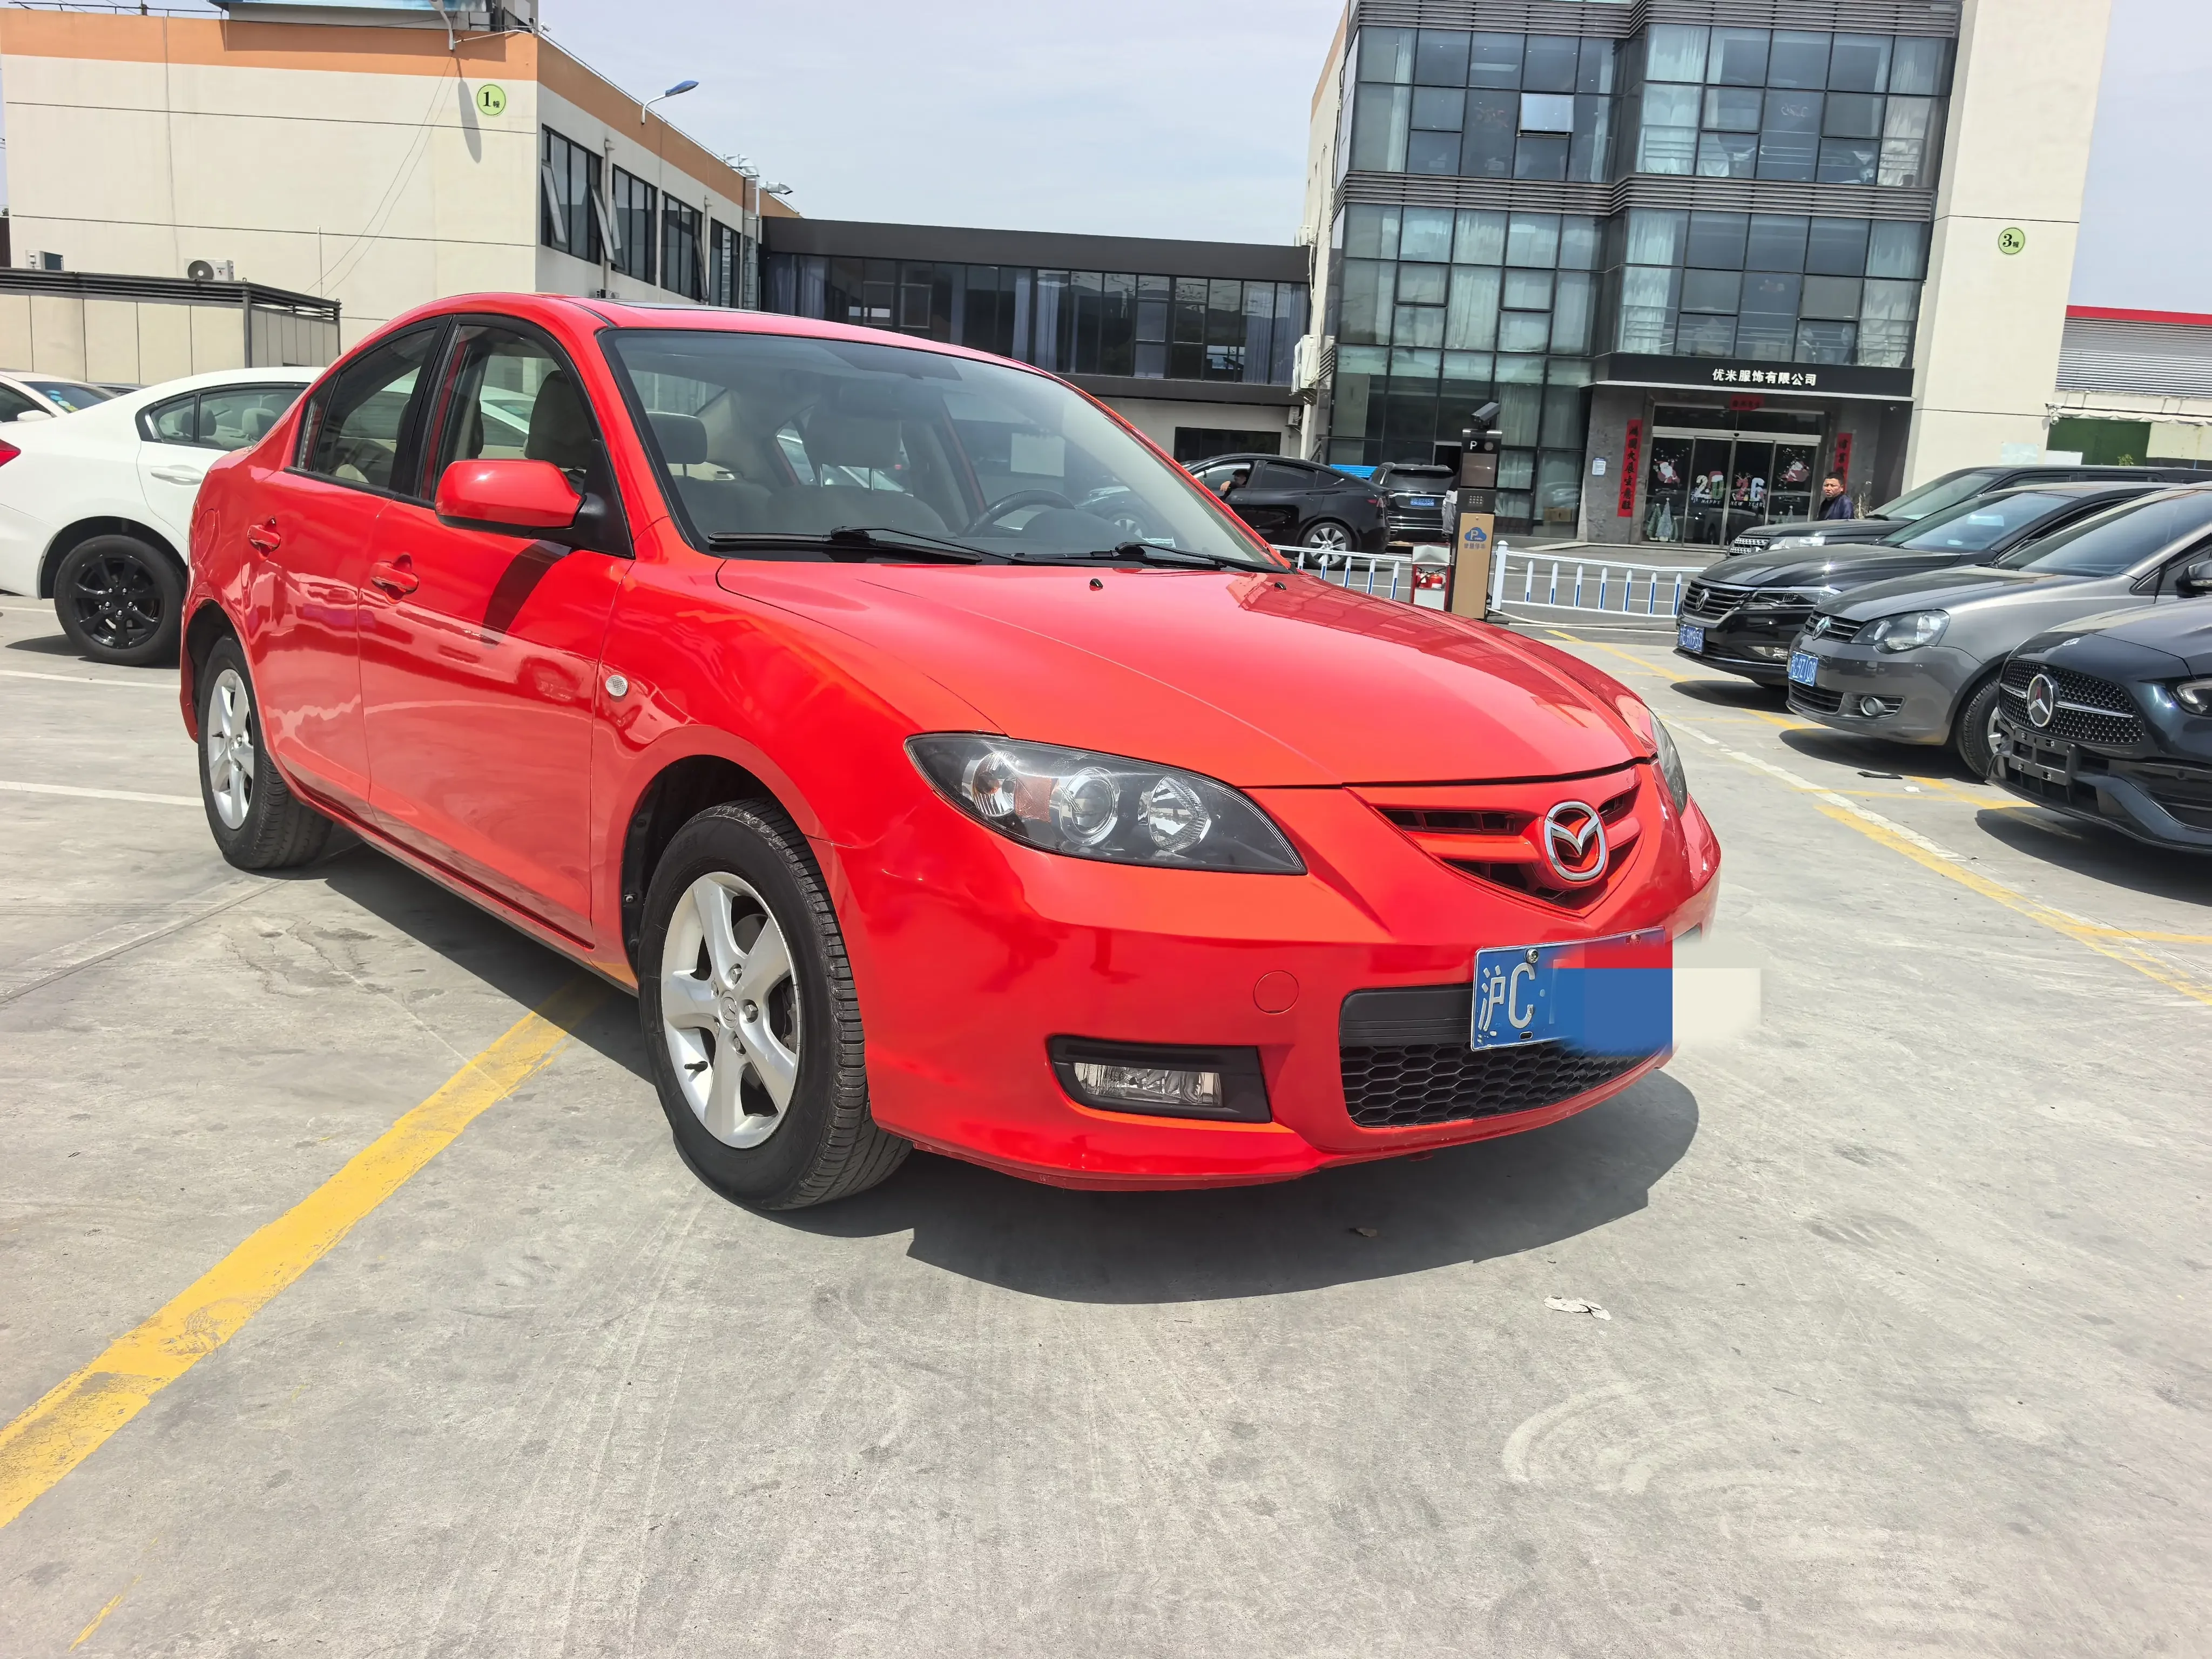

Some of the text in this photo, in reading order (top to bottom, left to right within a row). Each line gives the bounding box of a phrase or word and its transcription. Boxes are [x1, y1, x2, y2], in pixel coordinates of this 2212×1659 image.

[1712, 368, 1817, 386] 优米服饰有限公司
[1469, 440, 1478, 450] P
